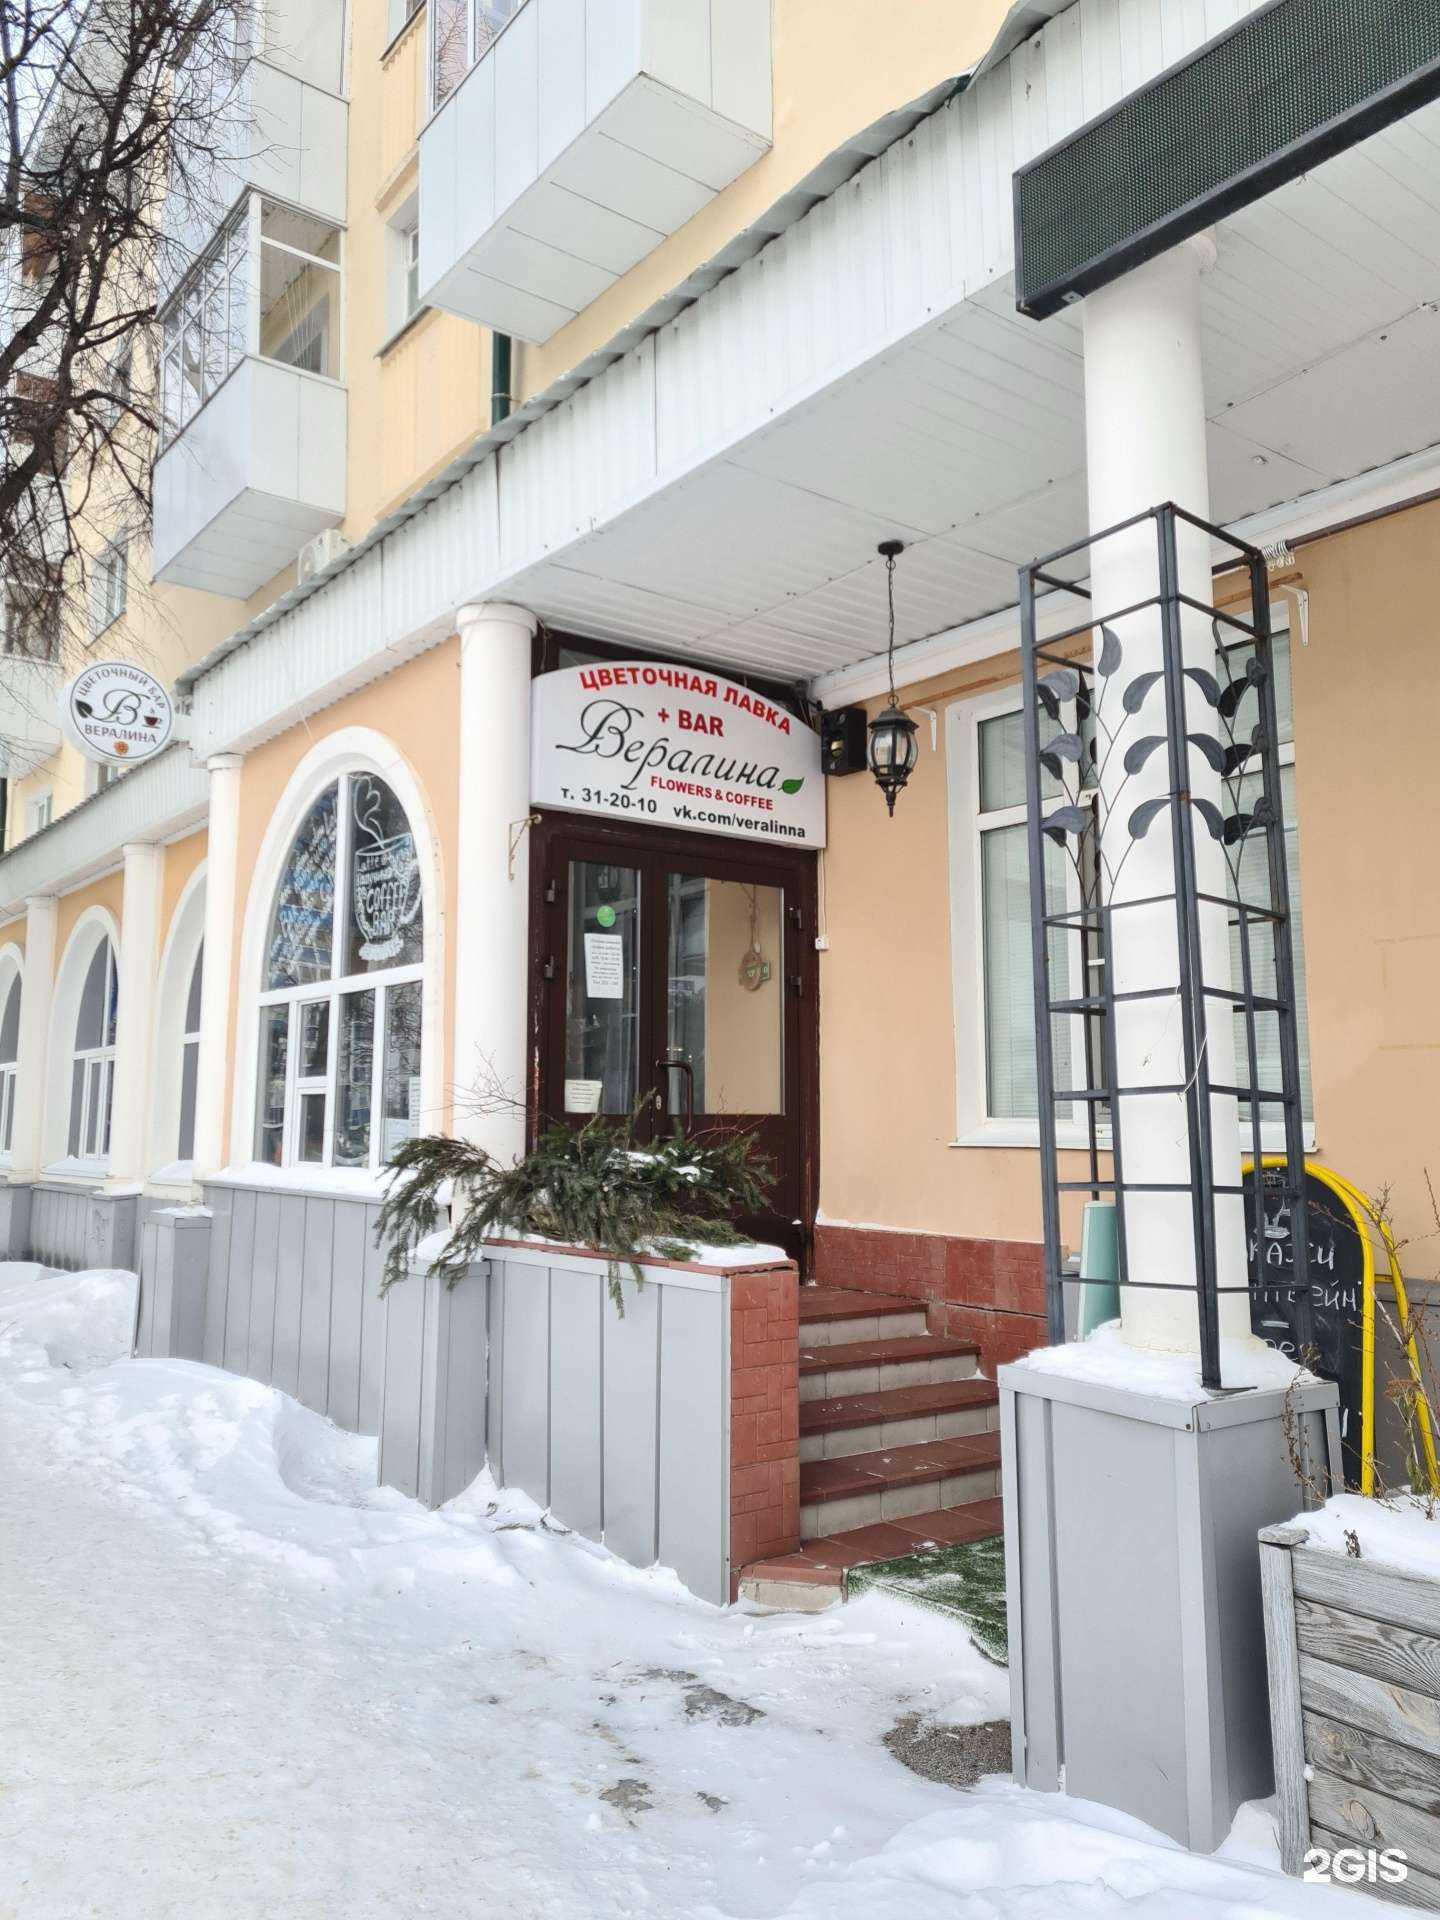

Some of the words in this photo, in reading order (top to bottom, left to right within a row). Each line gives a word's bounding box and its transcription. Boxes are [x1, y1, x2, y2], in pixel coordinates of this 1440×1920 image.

[78, 666, 148, 693] ЦВЕТОЧНЫЙ
[148, 686, 165, 709] БАР
[579, 667, 718, 698] ЦВЕТОЧНАЯ
[723, 689, 791, 735] ЛАВКА
[84, 724, 157, 744] ВЕРАЛИНА
[555, 699, 780, 790] Вералина
[678, 709, 724, 737] BAR
[560, 788, 574, 801] т.
[582, 788, 657, 813] 31-20-10
[673, 804, 806, 838] vk.com/veralinna
[650, 776, 712, 798] FLOWERS
[714, 789, 722, 801] &
[726, 792, 774, 811] COFFEE
